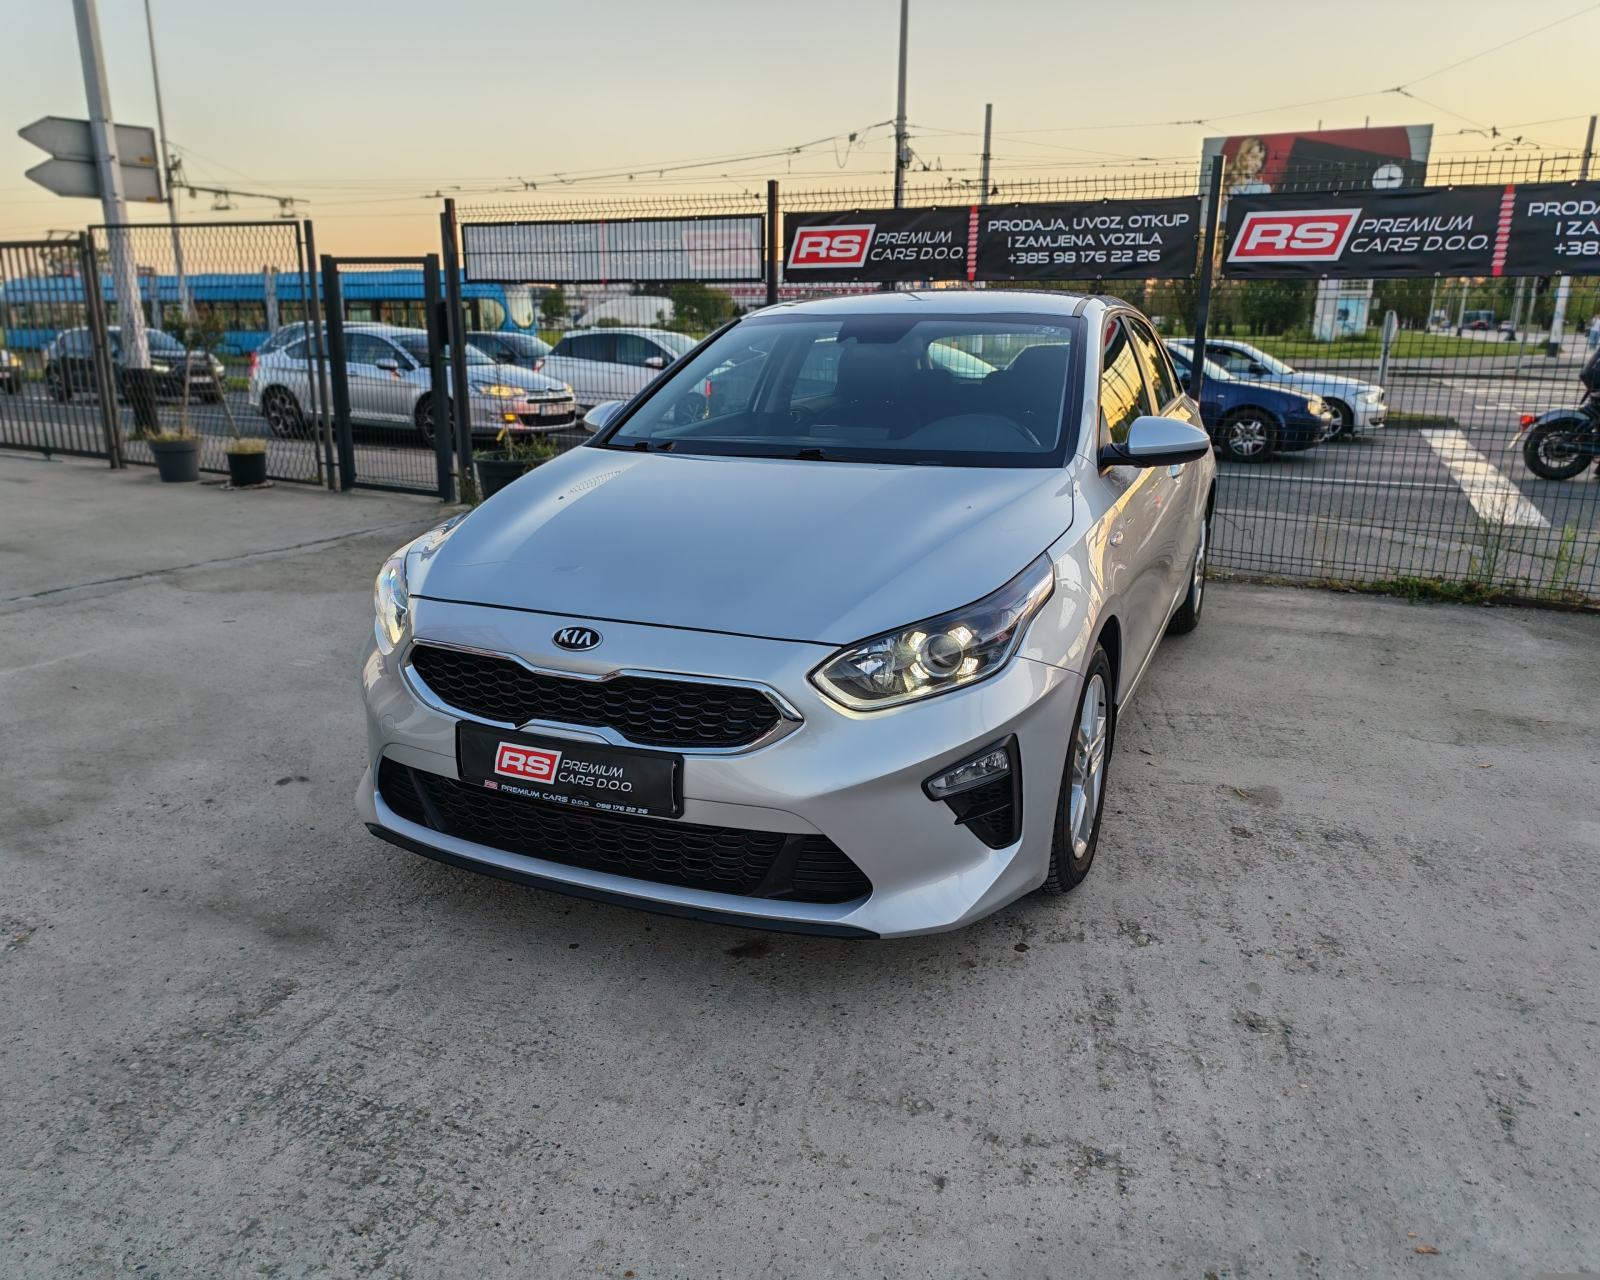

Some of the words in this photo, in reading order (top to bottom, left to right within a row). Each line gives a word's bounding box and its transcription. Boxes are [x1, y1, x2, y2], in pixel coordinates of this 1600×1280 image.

[1528, 200, 1600, 216] PROD
[988, 218, 1069, 232] PRODAJA,
[1073, 216, 1124, 230] UVOZ,
[1128, 214, 1189, 228] OTKUP
[1358, 215, 1473, 234] PREMIUM
[1556, 221, 1562, 235] I
[875, 231, 952, 245] PREMIUM
[1008, 236, 1012, 248] I
[1015, 234, 1095, 248] ZAMJENA
[1099, 232, 1162, 246] VOZILA
[1244, 222, 1339, 250] RS
[1350, 236, 1420, 252] CARS
[1423, 235, 1488, 251] D.O.O.
[799, 235, 861, 258] RS
[870, 248, 918, 261] CARS
[920, 247, 964, 260] D.O.O.
[1554, 241, 1600, 255] +38
[1008, 252, 1049, 264] +385
[1053, 251, 1076, 264] 98
[1080, 251, 1106, 263] 176
[1110, 250, 1133, 263] 22
[1137, 249, 1160, 262] 26
[558, 630, 591, 645] KIA
[501, 751, 551, 775] RS
[561, 759, 624, 778] PREMIUM
[558, 772, 595, 787] CARS
[596, 778, 633, 793] D.O.O.
[501, 784, 540, 798] PREMIUM
[543, 793, 568, 803] CARS
